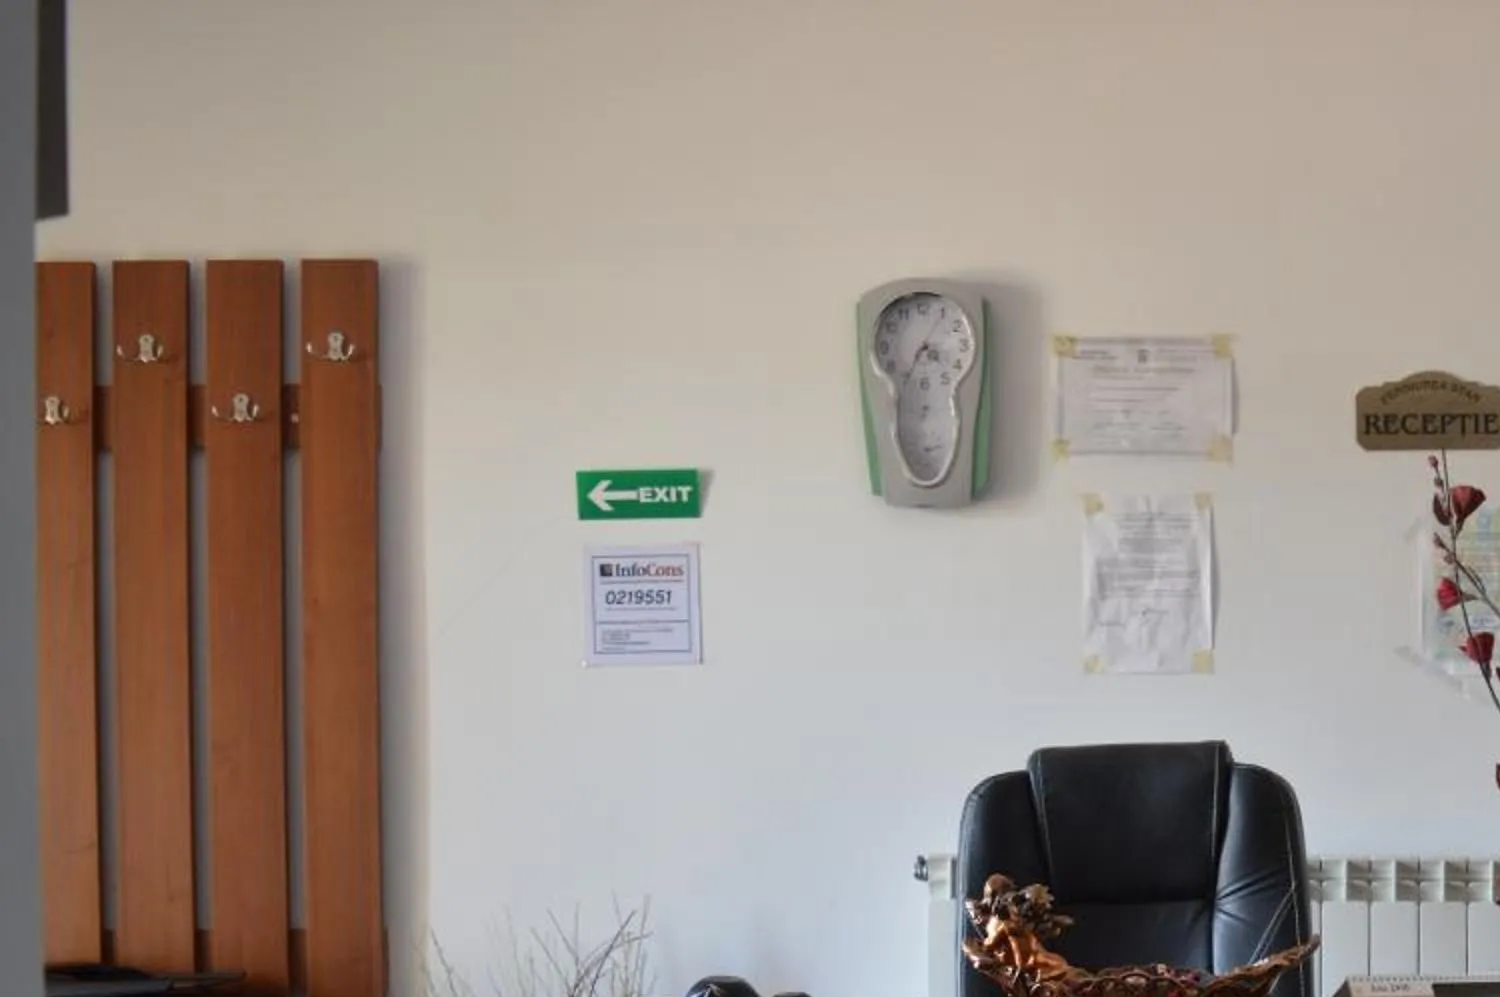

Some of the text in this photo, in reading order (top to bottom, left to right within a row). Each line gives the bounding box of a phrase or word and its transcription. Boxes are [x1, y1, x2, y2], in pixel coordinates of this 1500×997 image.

[639, 486, 693, 503] EXIT
[615, 562, 684, 577] InfoCons
[605, 590, 672, 605] 0219551
